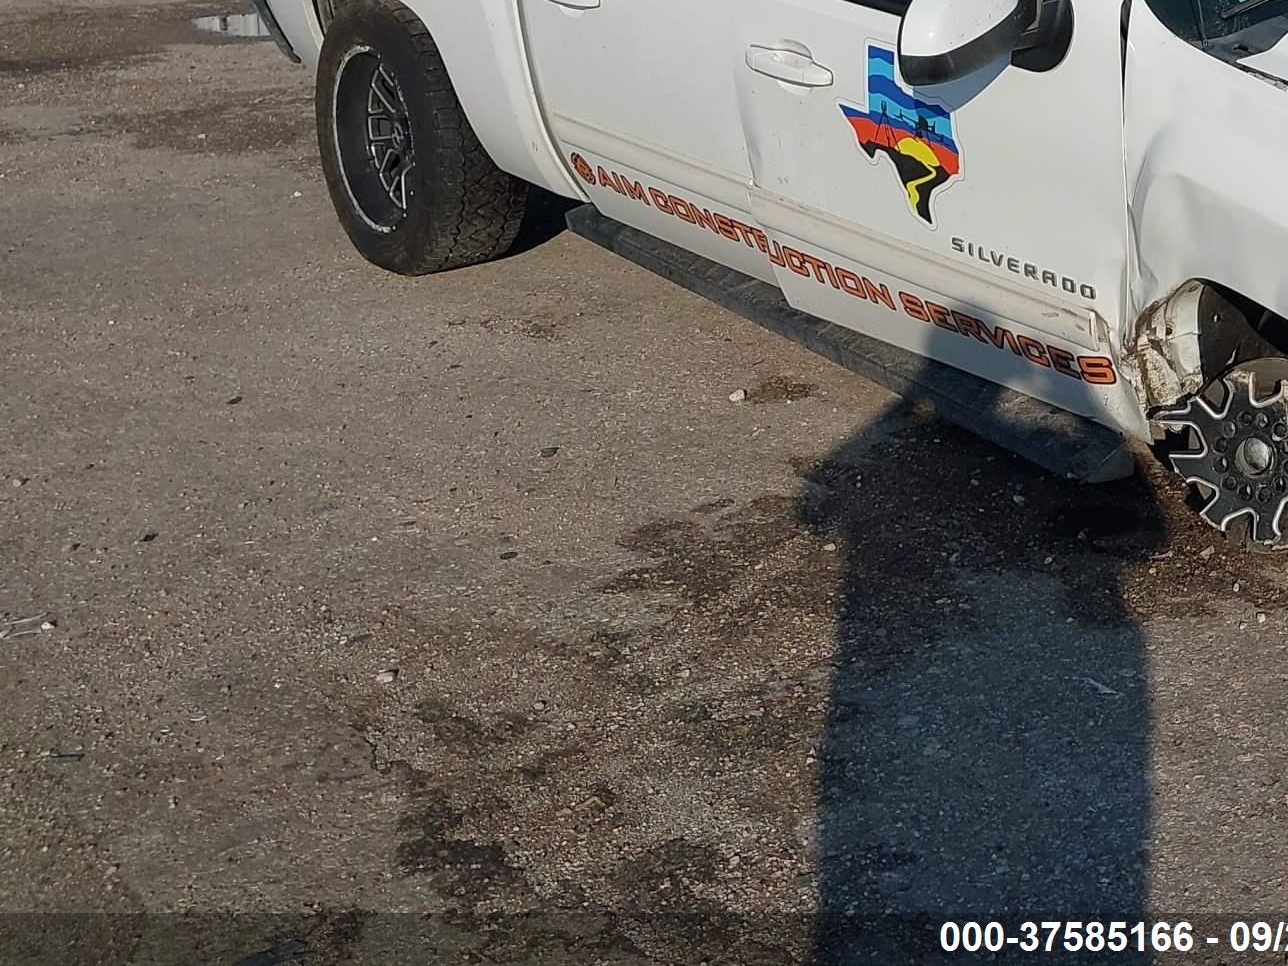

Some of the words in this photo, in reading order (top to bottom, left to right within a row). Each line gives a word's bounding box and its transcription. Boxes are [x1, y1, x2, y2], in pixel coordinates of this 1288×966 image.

[597, 165, 650, 206] AIM
[648, 186, 896, 311] CONSTRUCTION
[898, 290, 1117, 385] SERVICES
[951, 237, 1097, 300] SILVERADO
